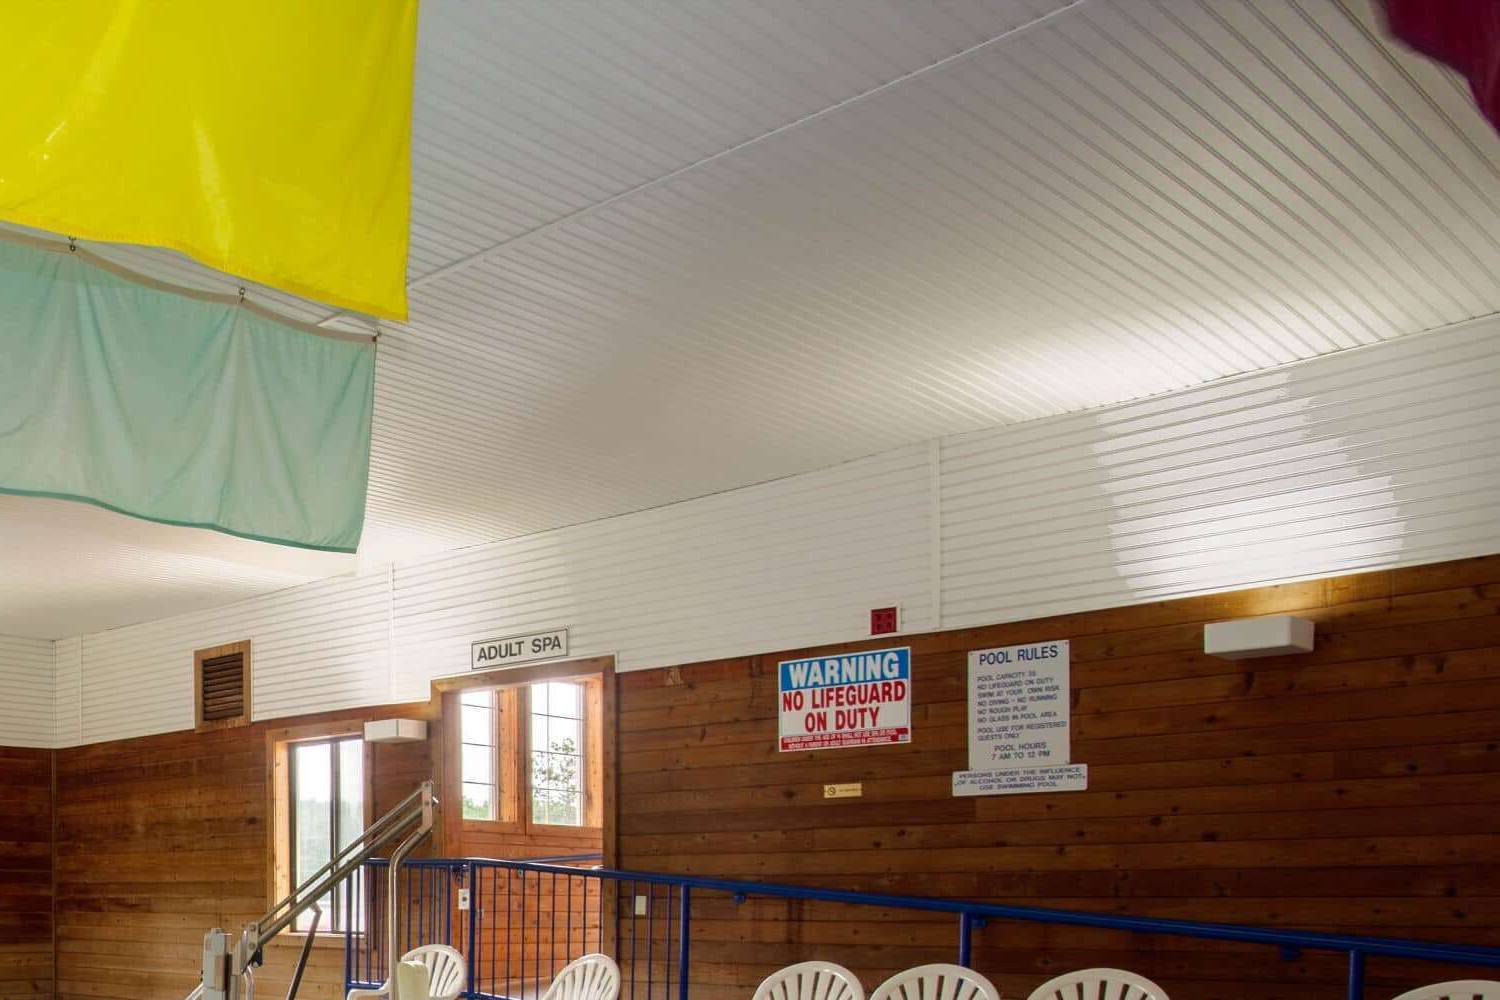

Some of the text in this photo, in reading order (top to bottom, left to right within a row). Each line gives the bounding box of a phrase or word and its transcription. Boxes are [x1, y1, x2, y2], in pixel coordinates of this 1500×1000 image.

[477, 635, 562, 662] ADULT SPA
[979, 645, 1058, 665] POOL RULES
[789, 652, 899, 689] WARNING
[996, 671, 1025, 680] CAPACITY
[988, 680, 1023, 689] LIFEGUARD
[783, 680, 906, 712] NO LIFEGUARD
[1005, 688, 1022, 696] YOUR
[989, 706, 1011, 714] ROUGH
[805, 706, 879, 733] ON DUTY
[1026, 721, 1067, 730] REGISTERED
[1019, 741, 1046, 750] HOURS
[1039, 767, 1080, 775] INFLUENCE
[970, 777, 1003, 785] ALCOHOL
[996, 782, 1035, 790] SWIMMING
